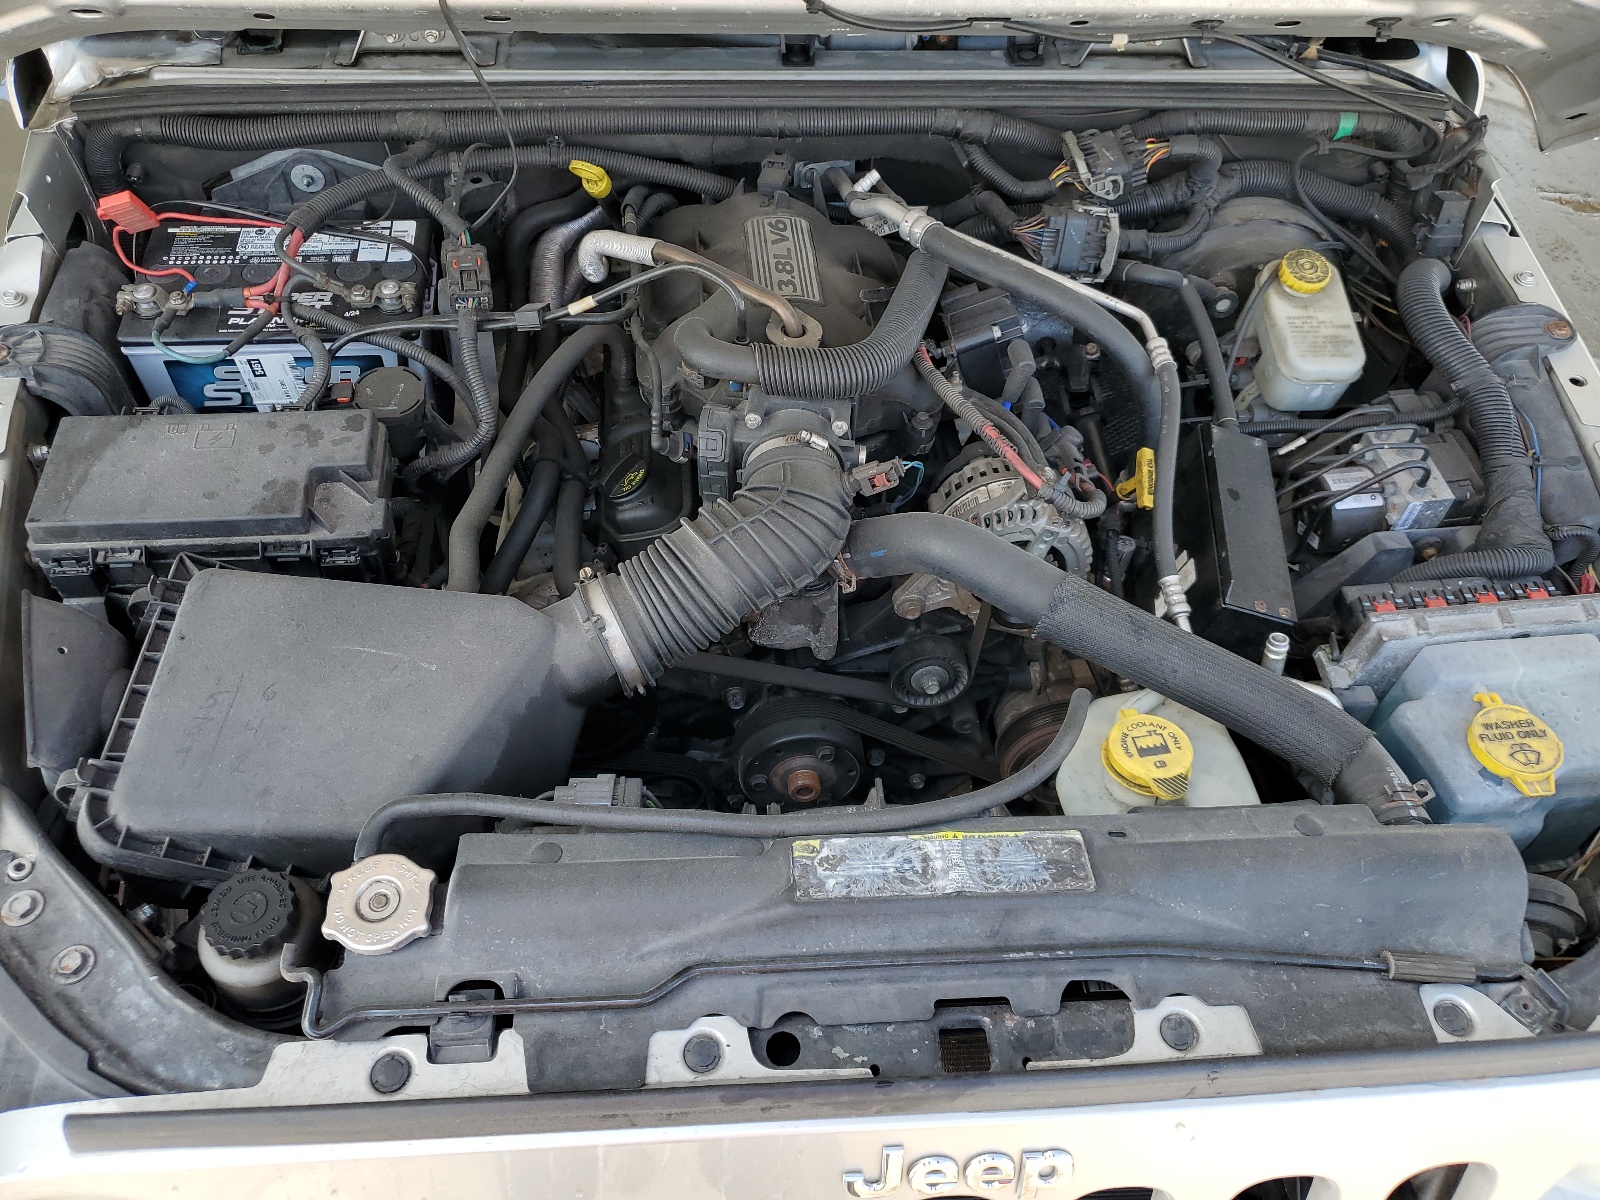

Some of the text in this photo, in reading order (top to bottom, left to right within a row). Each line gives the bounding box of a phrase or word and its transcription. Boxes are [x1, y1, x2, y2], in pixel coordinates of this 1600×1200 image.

[766, 219, 798, 294] 3.8L V6
[1479, 729, 1548, 743] FLUID ONLY
[1482, 719, 1536, 731] WASHER
[1119, 721, 1183, 758] ENGINE COOLANT ONLY
[347, 860, 380, 883] KEEP
[254, 916, 281, 939] FLUID
[365, 927, 399, 944] OPEN
[842, 1144, 1075, 1199] Jeep
